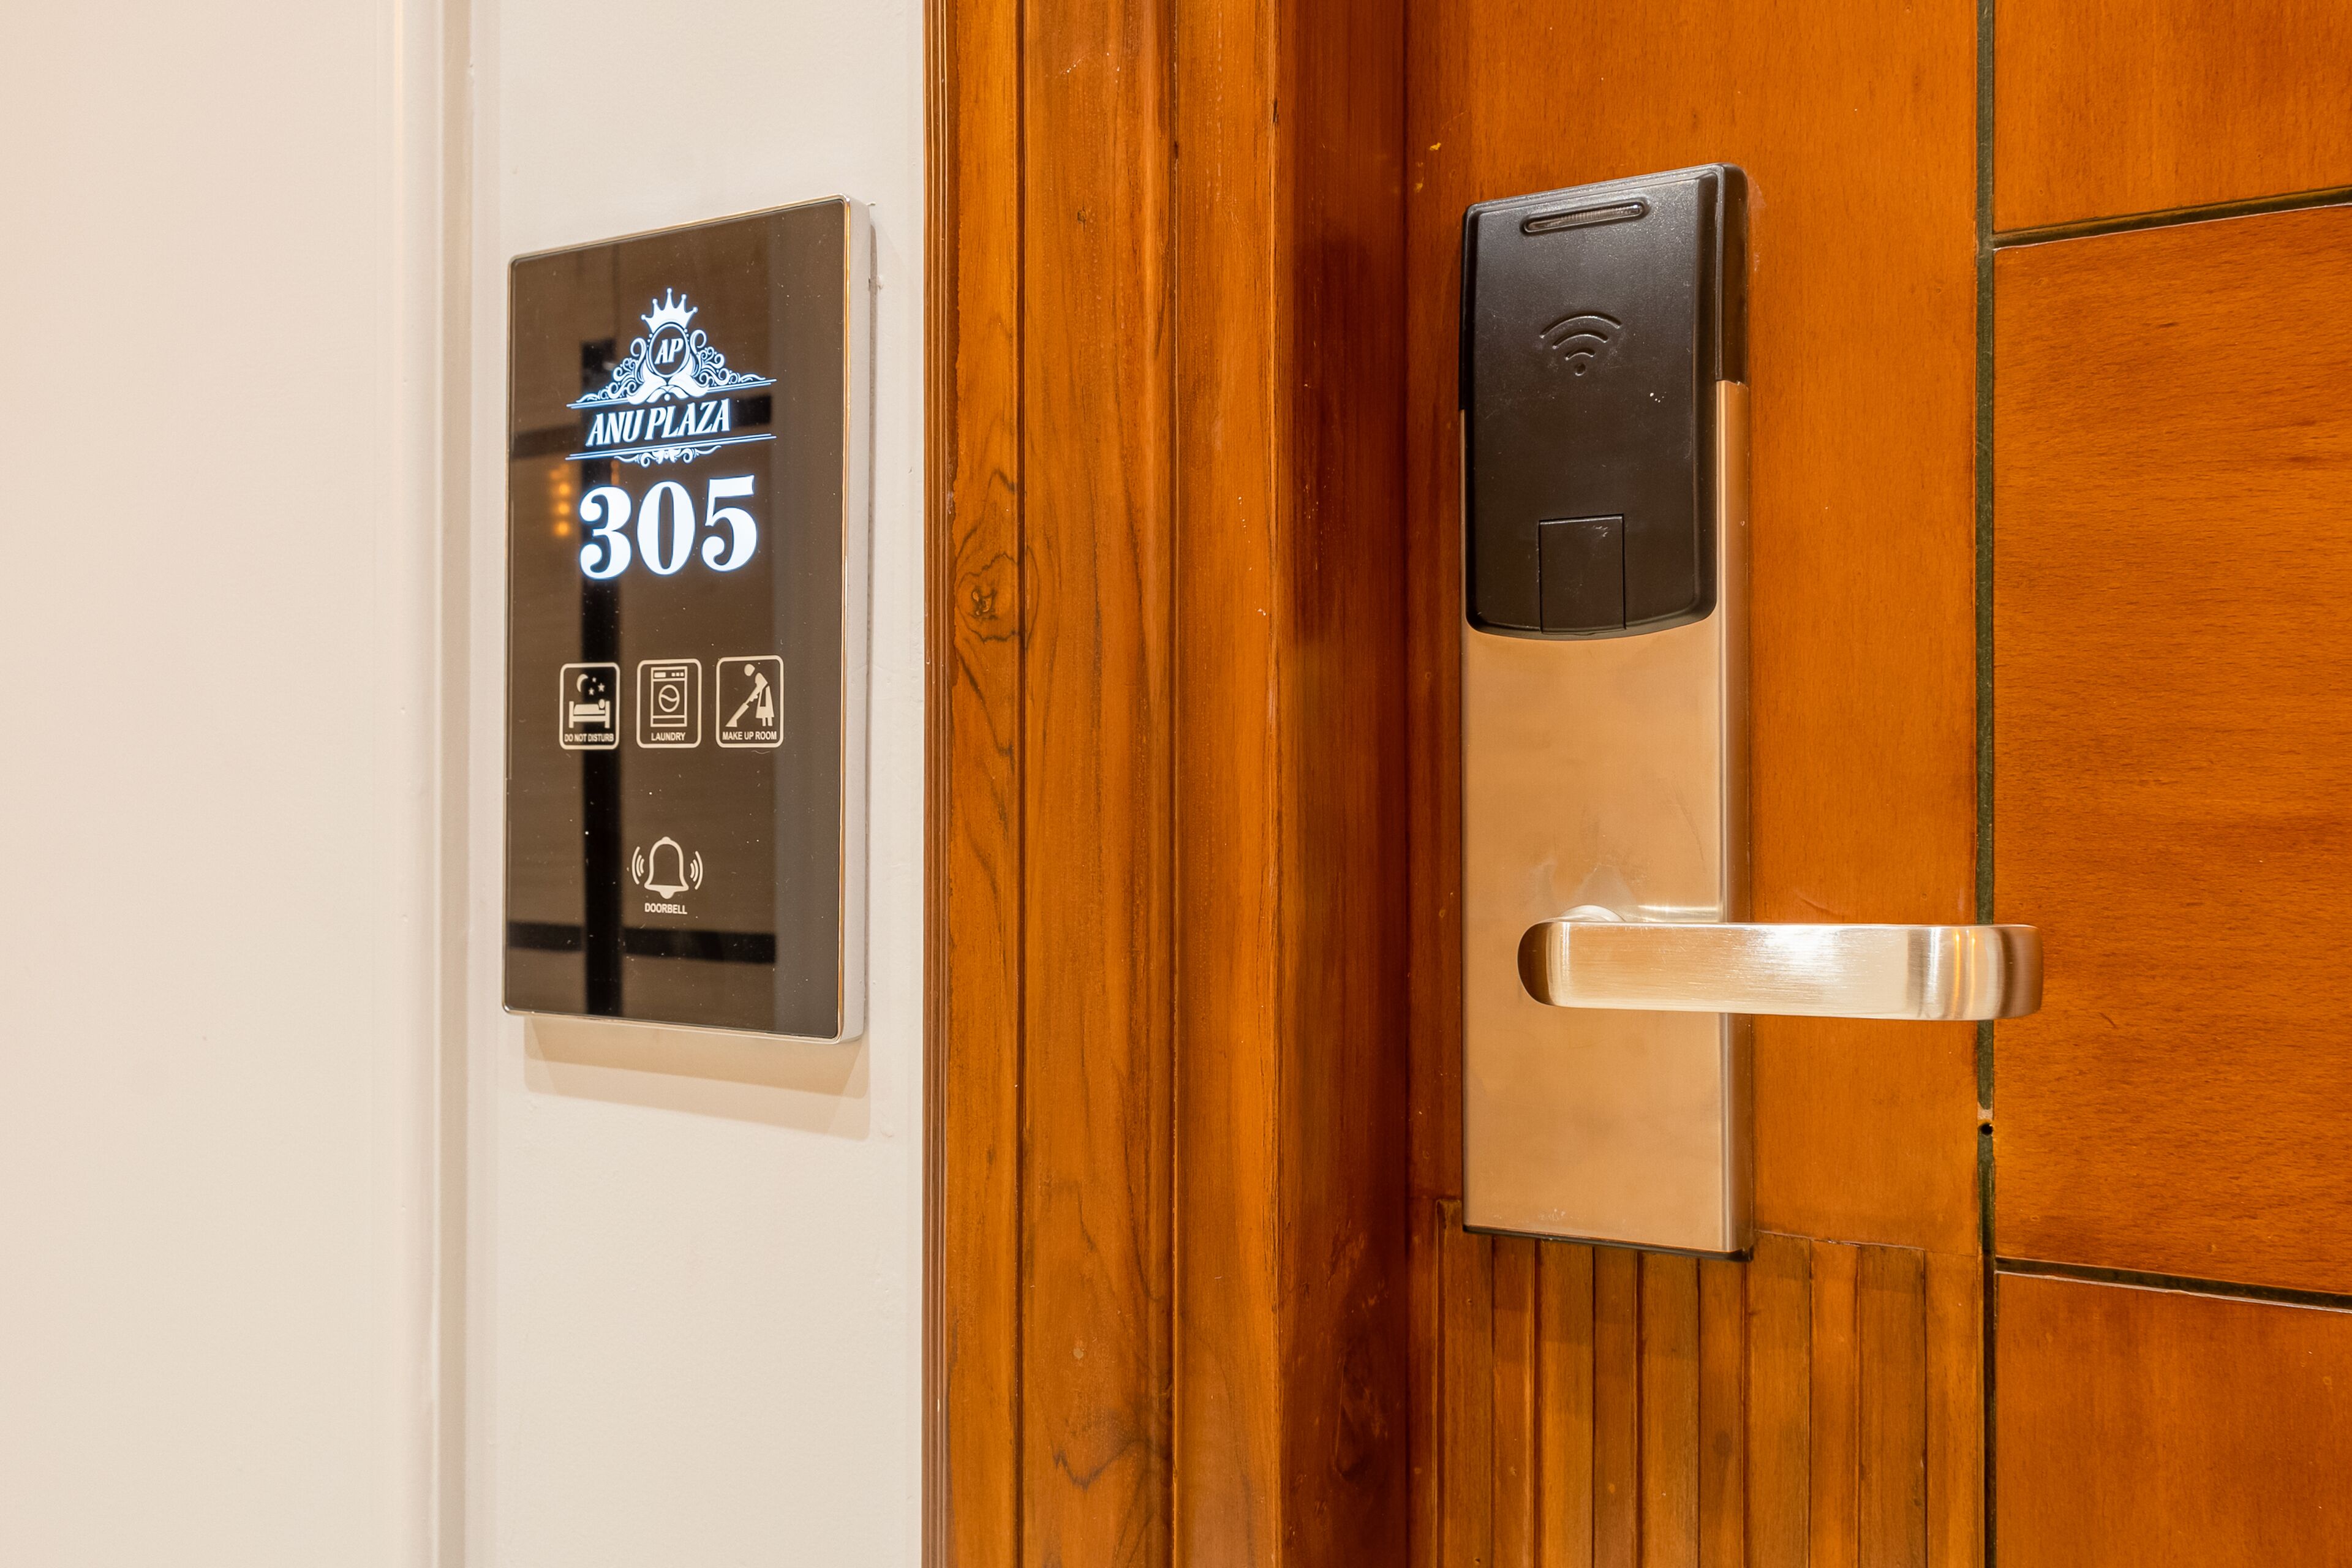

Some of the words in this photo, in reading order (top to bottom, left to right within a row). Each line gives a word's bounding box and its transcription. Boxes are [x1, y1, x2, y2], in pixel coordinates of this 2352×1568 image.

[655, 338, 684, 365] AP
[586, 409, 645, 447] ANU
[644, 398, 731, 440] PLAZA
[579, 475, 758, 580] 305
[564, 734, 573, 742] DO
[575, 734, 587, 742] NOT
[587, 734, 614, 742] DISTURB
[651, 732, 686, 741] LAUNDRY
[722, 731, 743, 741] MAKE
[744, 731, 754, 740] UP
[755, 731, 777, 740] ROOM
[644, 903, 687, 914] DOORBELL
